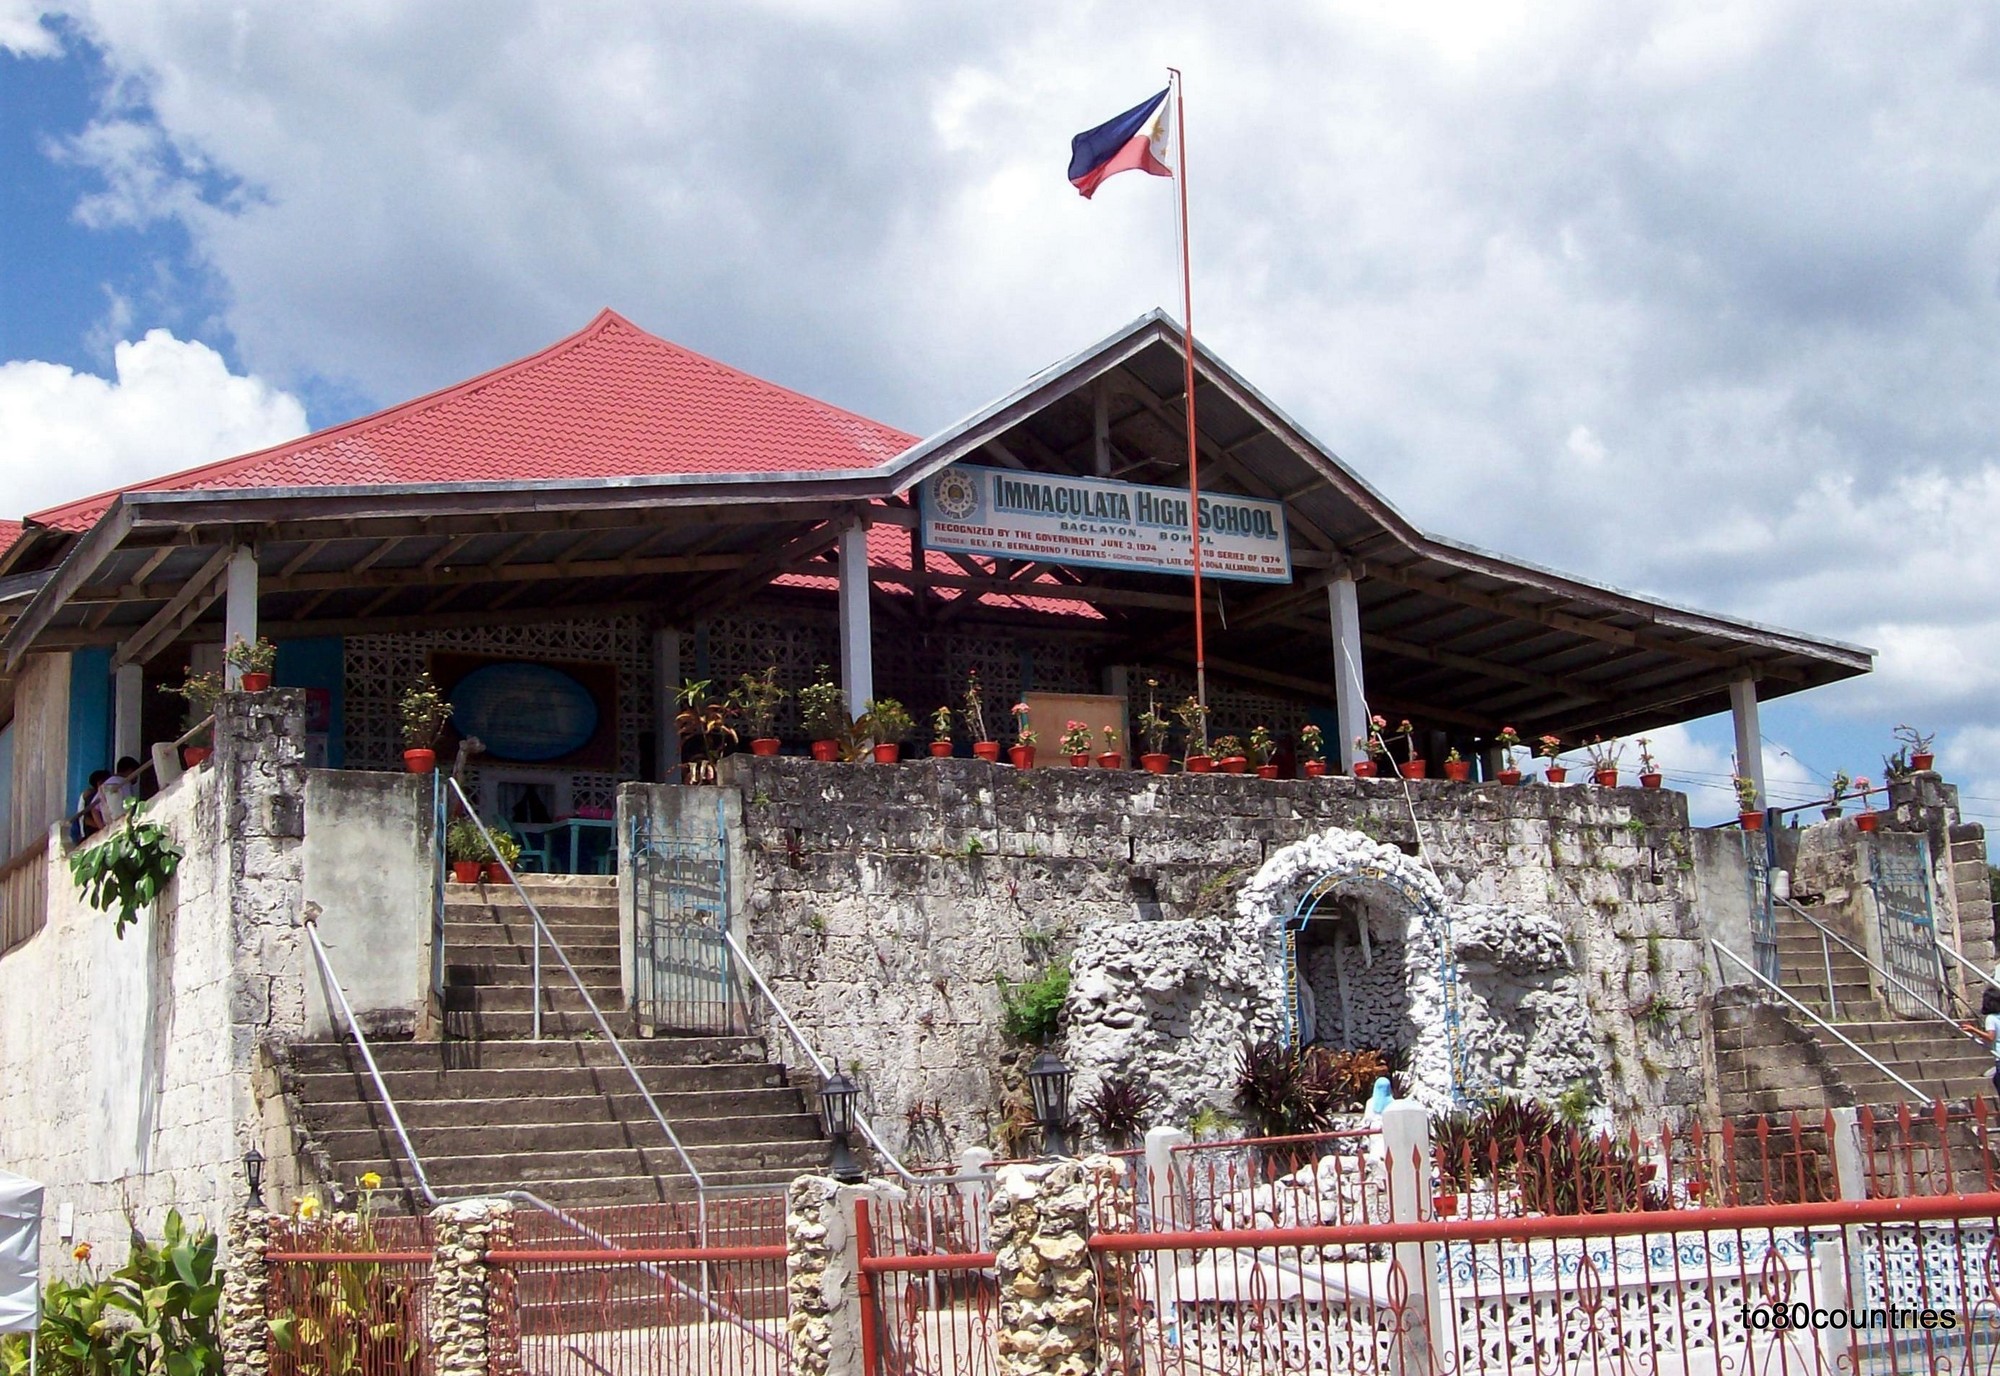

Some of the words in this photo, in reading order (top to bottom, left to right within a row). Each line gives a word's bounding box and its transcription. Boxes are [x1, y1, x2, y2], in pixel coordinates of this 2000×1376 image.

[994, 474, 1131, 521] IMMACULATA
[1136, 491, 1189, 528] HIGH
[1197, 497, 1279, 538] SCHOOL
[934, 522, 994, 537] RECOGNIZED
[998, 529, 1010, 538] BY
[1015, 530, 1032, 540] THE
[1035, 533, 1095, 546] GOVERNMENT
[1101, 540, 1123, 549] JUNE
[1217, 551, 1244, 561] SERIES
[1007, 542, 1061, 554] BERNARDINO
[1160, 531, 1214, 545] BOHOL
